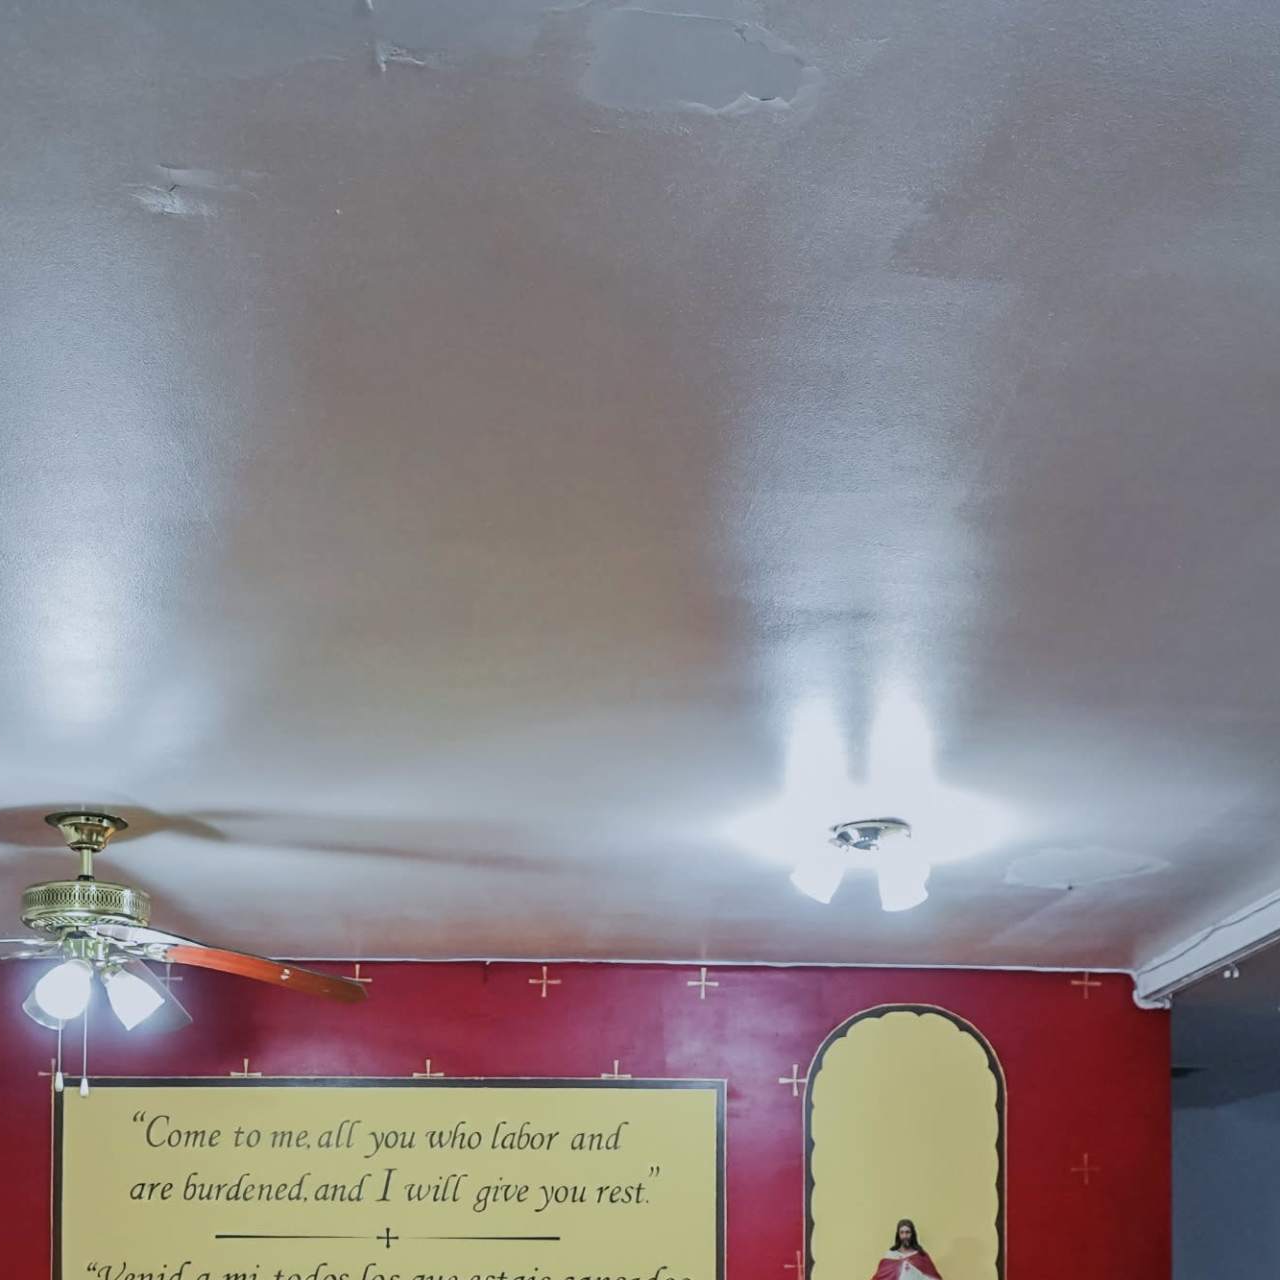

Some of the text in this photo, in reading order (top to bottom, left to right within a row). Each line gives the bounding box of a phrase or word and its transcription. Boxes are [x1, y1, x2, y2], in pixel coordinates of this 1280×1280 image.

[132, 1110, 222, 1148] “Come
[233, 1125, 262, 1149] to
[316, 1119, 362, 1149] all
[363, 1130, 416, 1159] you
[424, 1120, 483, 1151] who
[490, 1120, 561, 1151] labor
[570, 1120, 630, 1152] and
[129, 1181, 174, 1201] are
[313, 1172, 373, 1203] and
[374, 1167, 398, 1203] I
[403, 1173, 469, 1203] will
[472, 1176, 530, 1214] give
[533, 1184, 587, 1213] you
